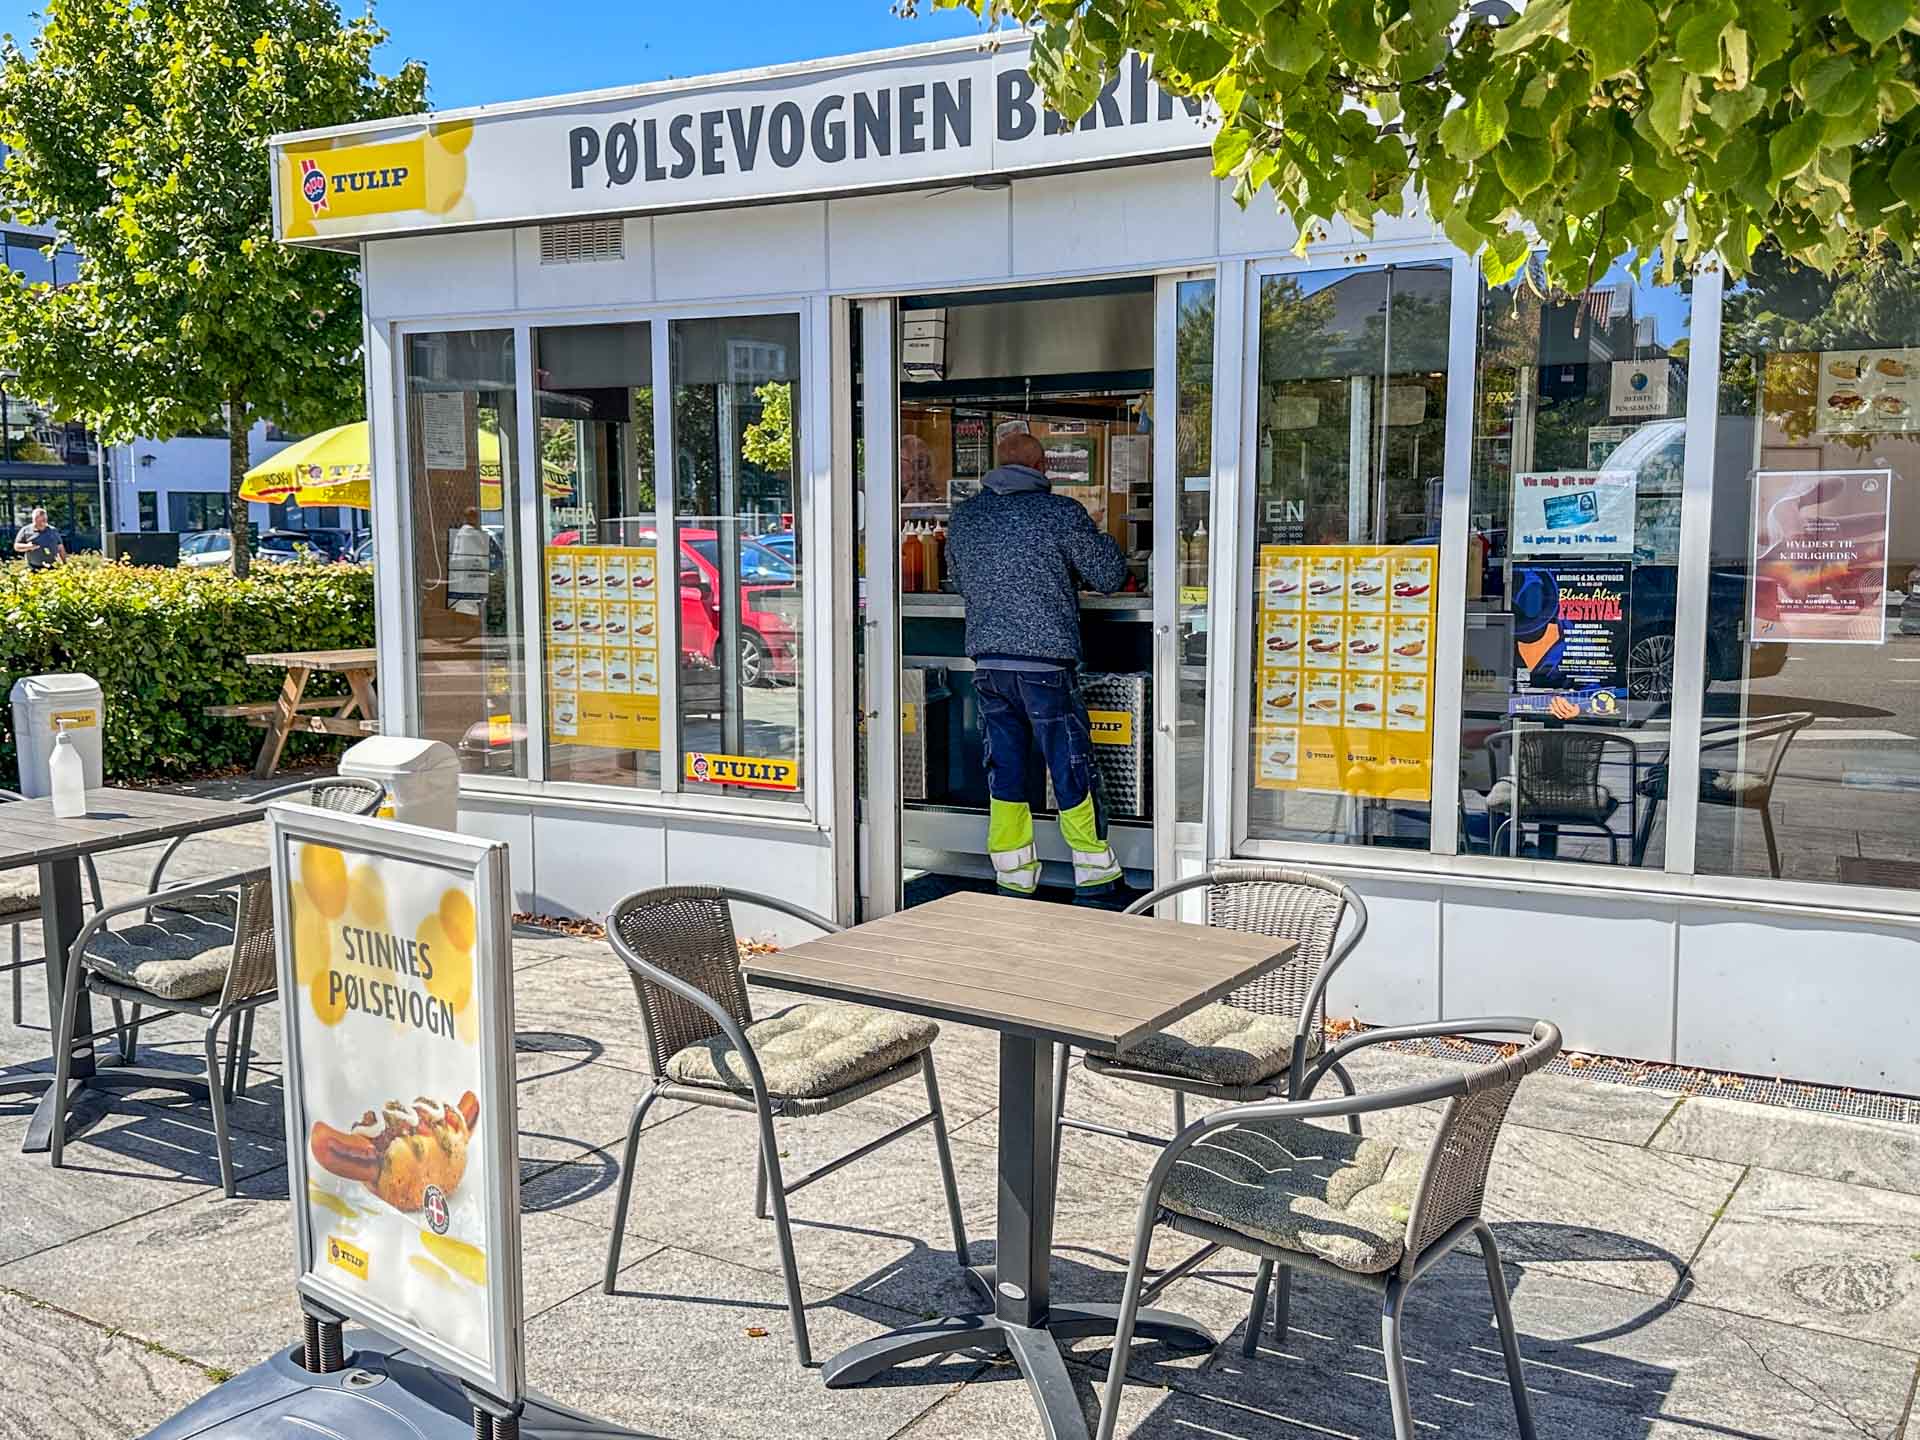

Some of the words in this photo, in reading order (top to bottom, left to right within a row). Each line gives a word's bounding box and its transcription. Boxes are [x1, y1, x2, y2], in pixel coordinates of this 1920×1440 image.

[569, 78, 972, 189] PØLSEVOGNEN
[331, 167, 409, 193] TULIP
[1541, 475, 1559, 488] mig
[1562, 475, 1576, 486] dit
[1535, 534, 1556, 545] giver
[1558, 534, 1571, 545] jeg
[1785, 540, 1835, 548] HYLDEST
[1839, 540, 1856, 548] TIL
[1779, 552, 1858, 560] KÆRLIGHEDEN
[1558, 587, 1589, 601] Blues
[1592, 587, 1622, 601] Alive
[1558, 599, 1622, 621] FESTIVAL
[713, 760, 789, 781] TULIP
[342, 925, 433, 980] STINNES
[329, 970, 455, 1041] PØLSEVOGN
[340, 1249, 365, 1268] TULIP
